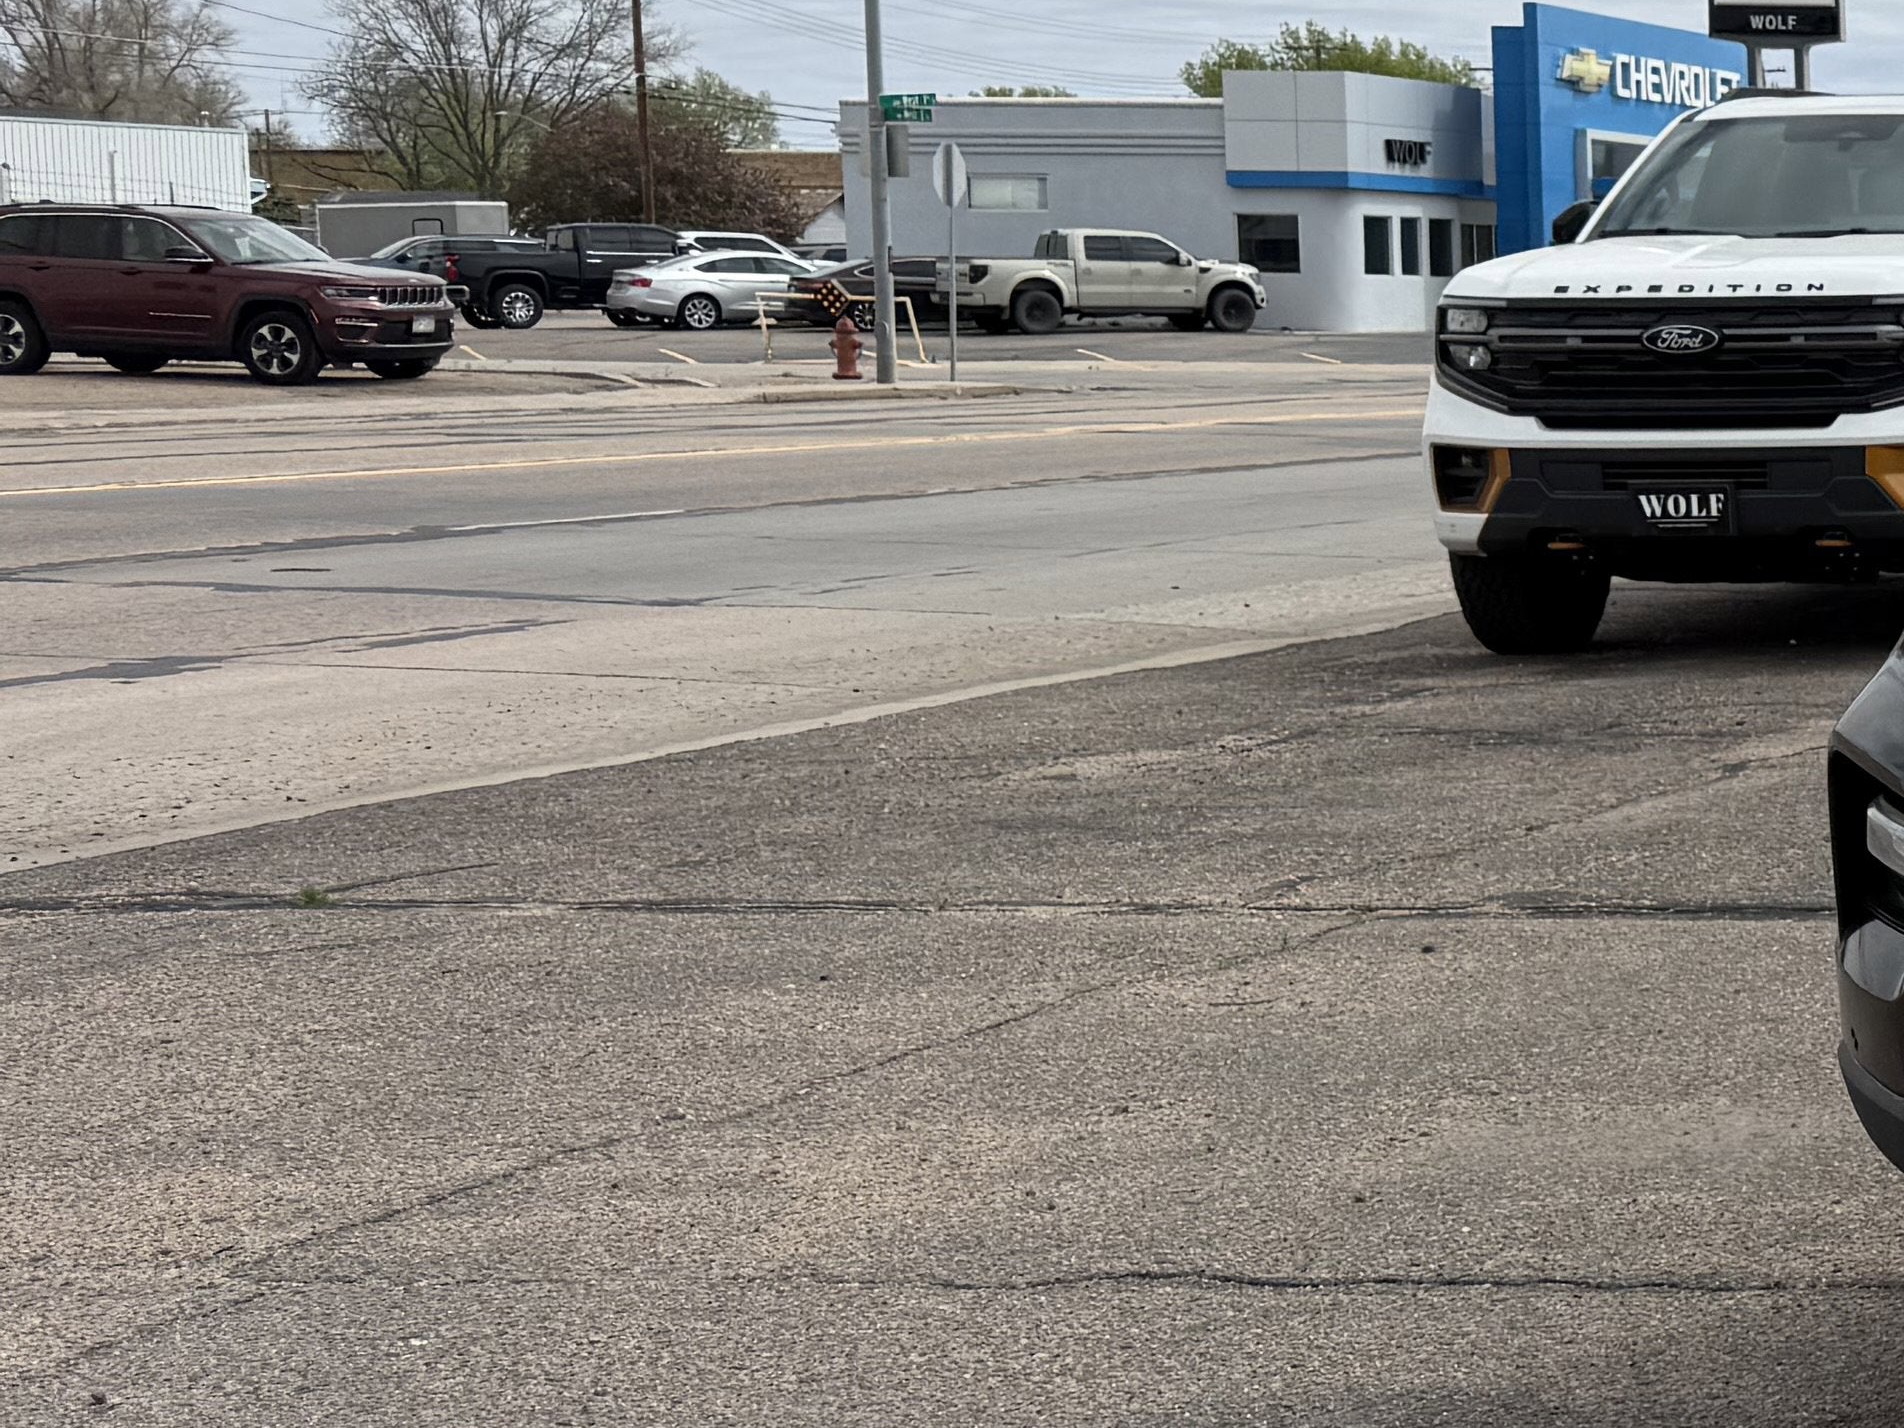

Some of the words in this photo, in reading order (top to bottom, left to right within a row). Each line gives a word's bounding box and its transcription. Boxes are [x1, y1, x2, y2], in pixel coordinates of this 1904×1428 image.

[1749, 14, 1798, 31] WOLF
[1612, 52, 1741, 109] CHEVROLET
[1384, 138, 1432, 166] WOLF
[1553, 283, 1825, 294] EXPEDITION
[1656, 328, 1704, 349] Ford
[1637, 493, 1725, 518] WOLF
